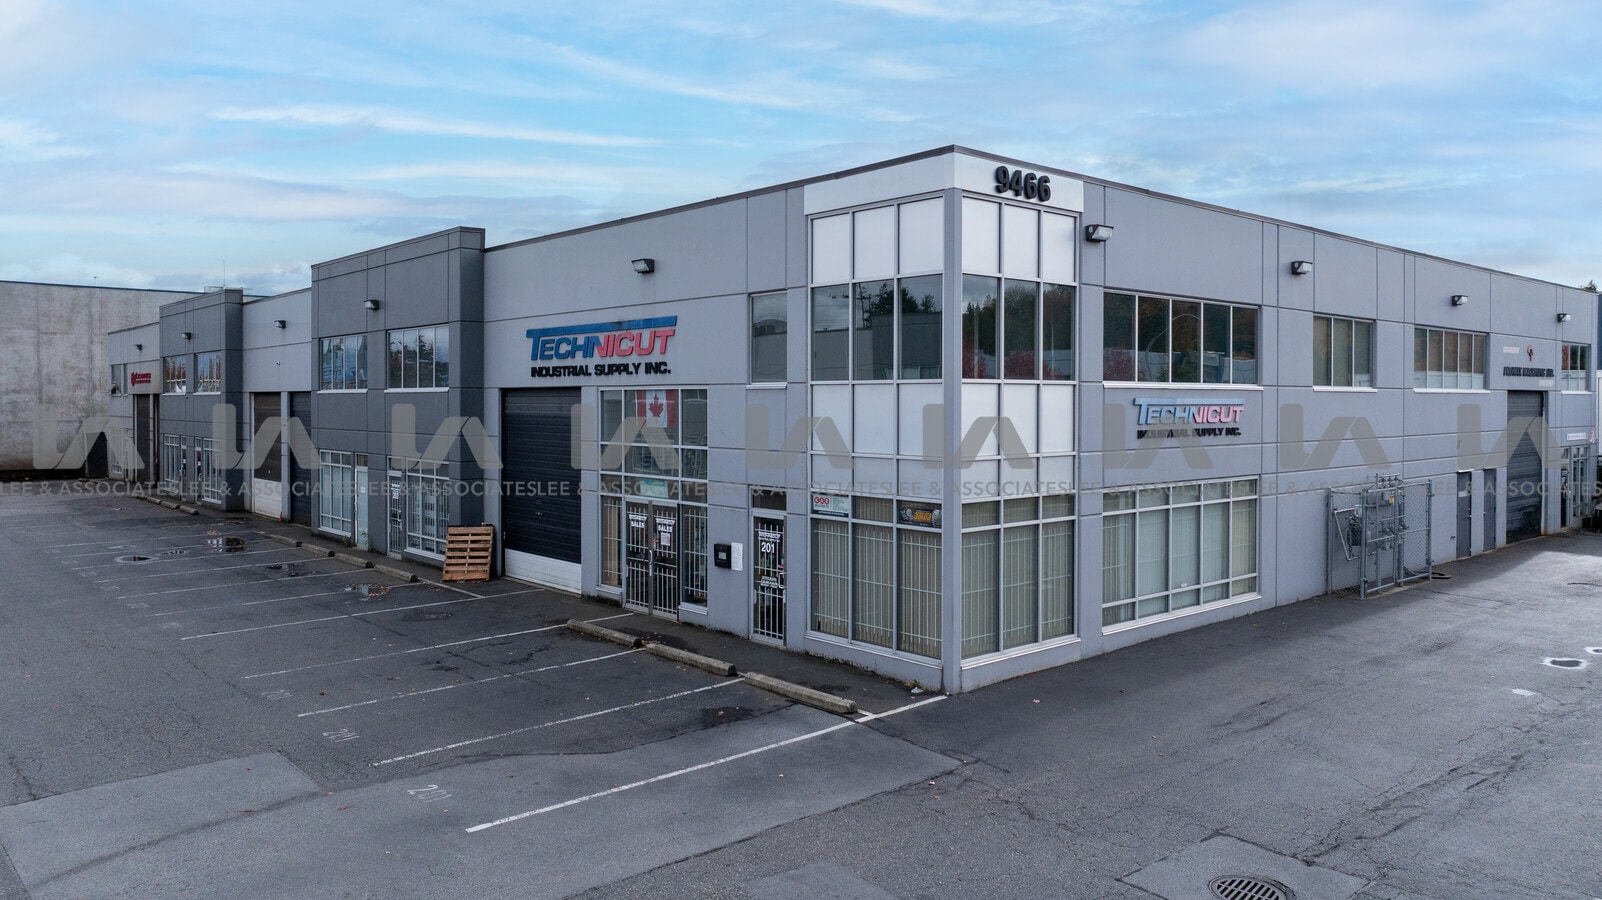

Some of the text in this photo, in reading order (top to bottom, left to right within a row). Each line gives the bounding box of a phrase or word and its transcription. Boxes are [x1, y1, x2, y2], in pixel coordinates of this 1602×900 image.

[994, 165, 1051, 203] 9466
[526, 315, 678, 361] TECHNICUT
[531, 361, 671, 378] INDUSTRIAL SUPPLY INC.
[1132, 397, 1247, 425] TECHNICUT
[1192, 427, 1224, 437] SUPPLY
[1225, 427, 1242, 436] INC.
[761, 542, 775, 554] 201
